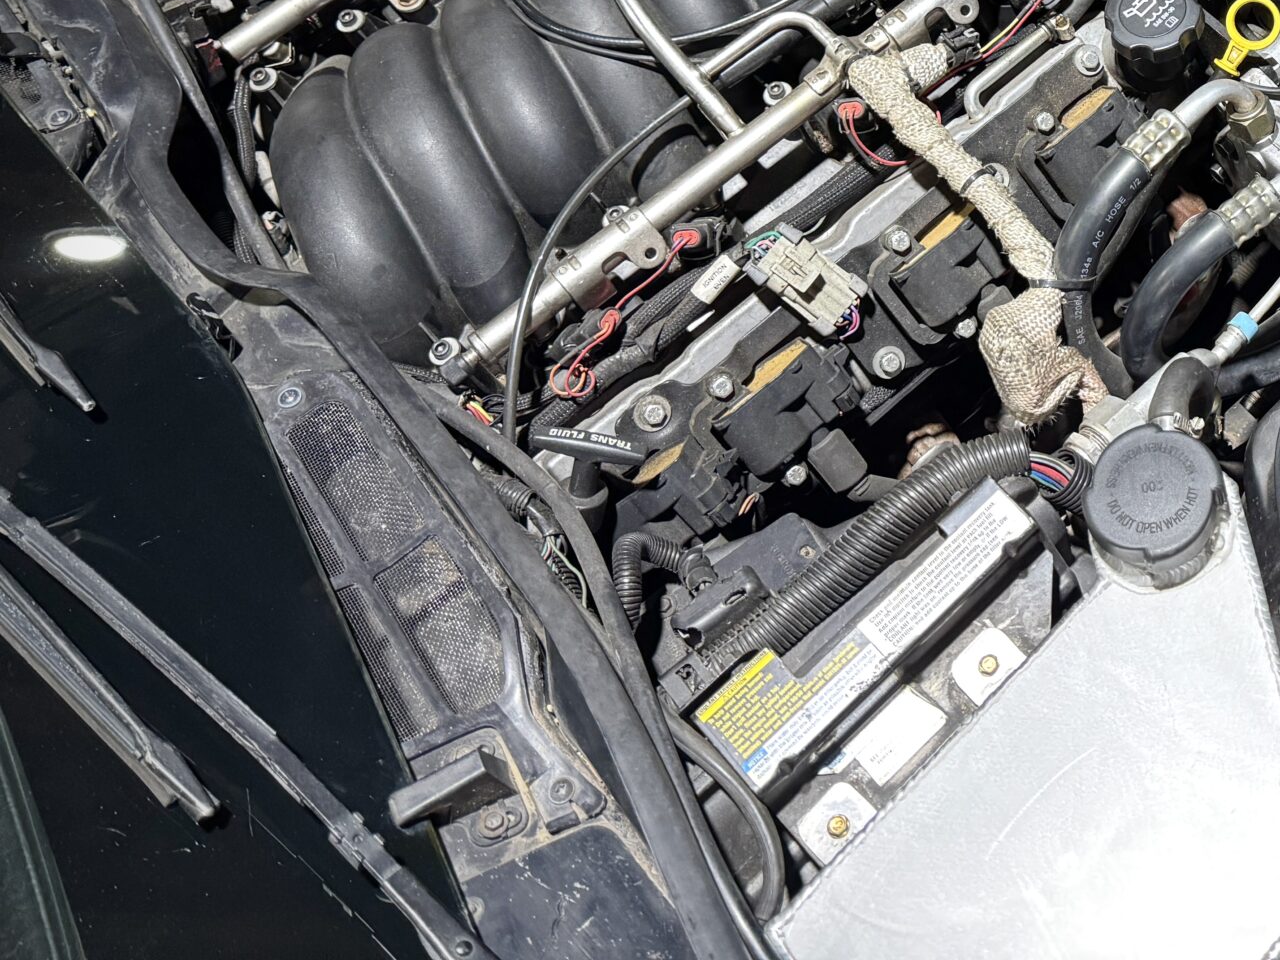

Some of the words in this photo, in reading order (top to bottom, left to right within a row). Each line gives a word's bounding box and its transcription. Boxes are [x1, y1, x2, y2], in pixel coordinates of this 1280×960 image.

[1075, 326, 1085, 346] SAE
[1092, 230, 1105, 249] A/C
[1105, 195, 1127, 223] HOSE
[1129, 177, 1142, 191] 1/2
[702, 263, 726, 287] IGNITION
[548, 425, 585, 440] FLUID
[589, 433, 632, 450] TRANS
[1106, 499, 1121, 514] DO
[1115, 510, 1136, 529] NOT
[1135, 520, 1162, 533] OPEN
[1162, 505, 1190, 528] WHEN
[1184, 486, 1199, 506] HOT
[726, 676, 747, 695] CAUTION
